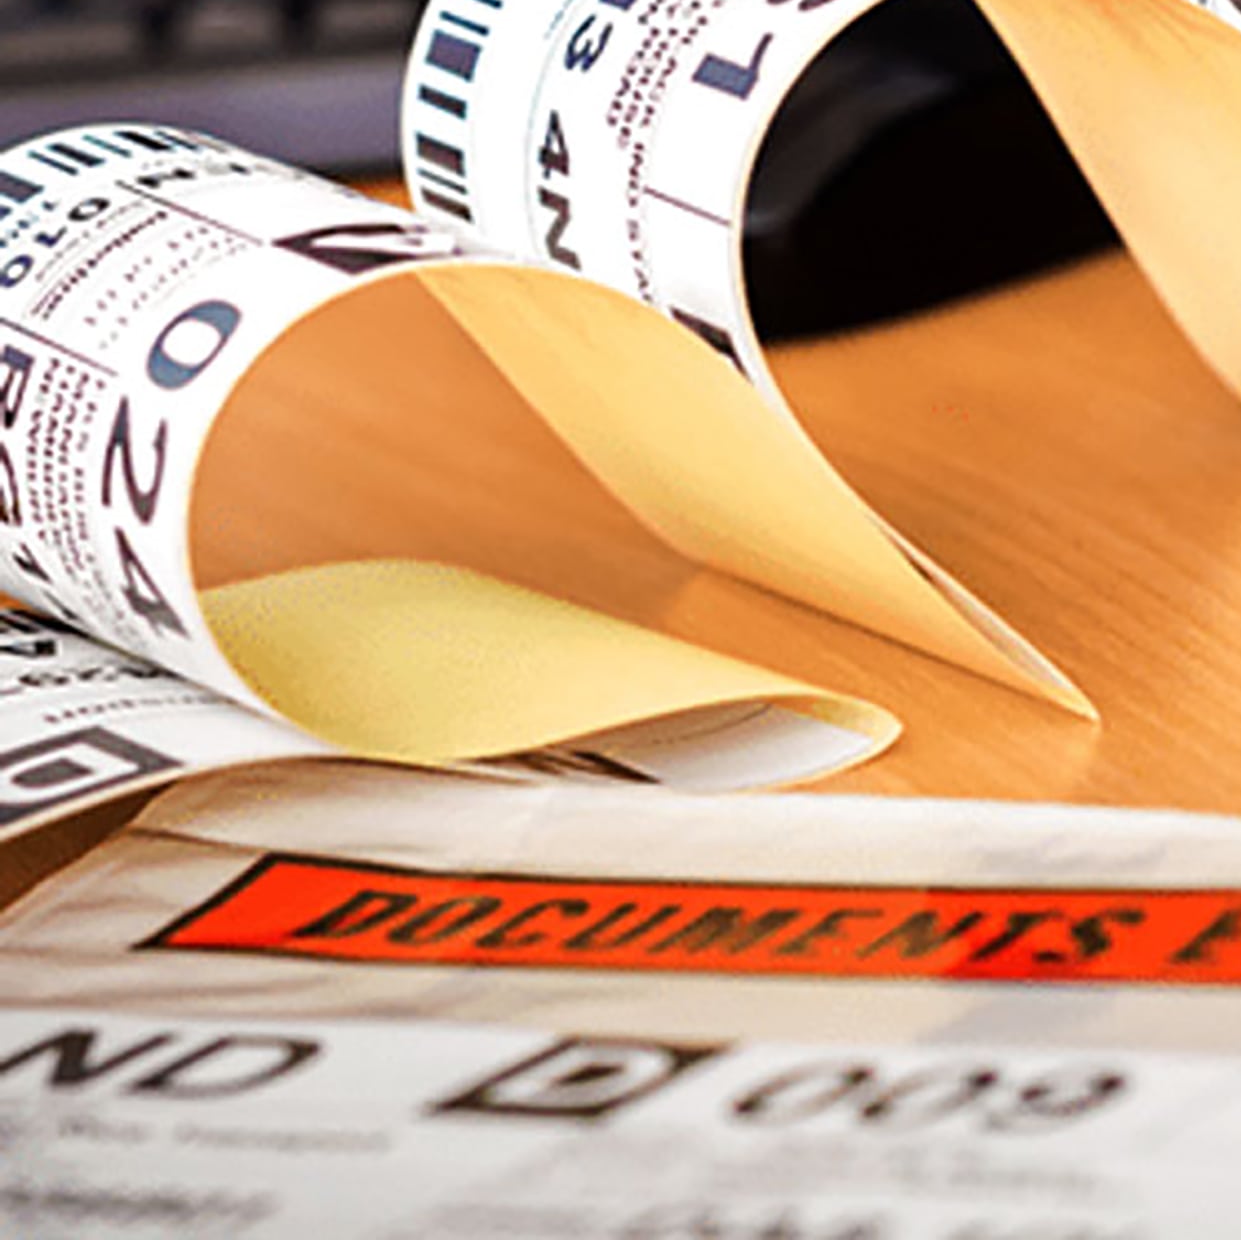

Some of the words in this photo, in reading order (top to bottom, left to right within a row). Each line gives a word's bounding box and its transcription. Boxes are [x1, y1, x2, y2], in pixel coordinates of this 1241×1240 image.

[101, 298, 242, 640] 024
[290, 887, 1147, 964] DOCUMENTS
[728, 1058, 1130, 1133] 009
